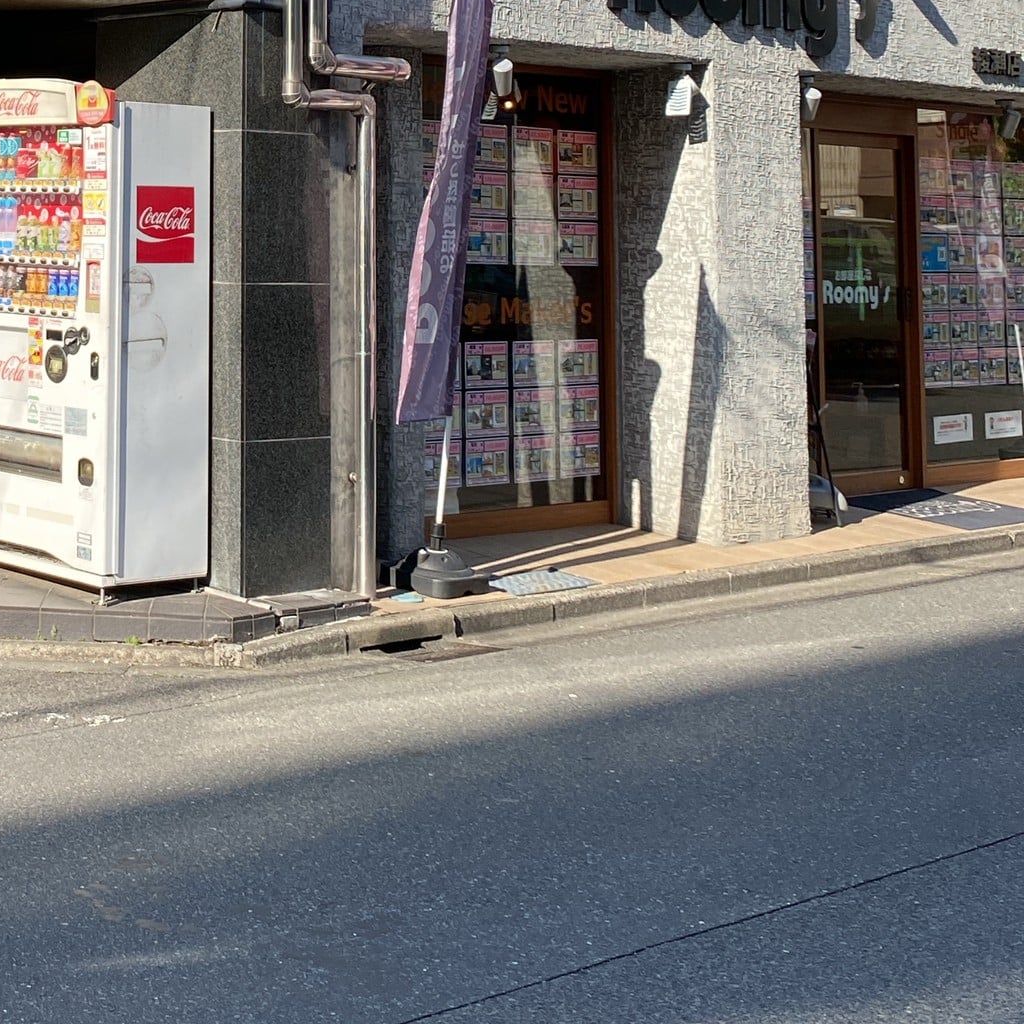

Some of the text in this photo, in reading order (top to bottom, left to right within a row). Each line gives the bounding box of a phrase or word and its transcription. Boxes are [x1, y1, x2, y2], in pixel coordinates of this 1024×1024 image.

[537, 84, 589, 114] New
[139, 206, 193, 231] Coca-Cola
[822, 279, 891, 310] Roomy's
